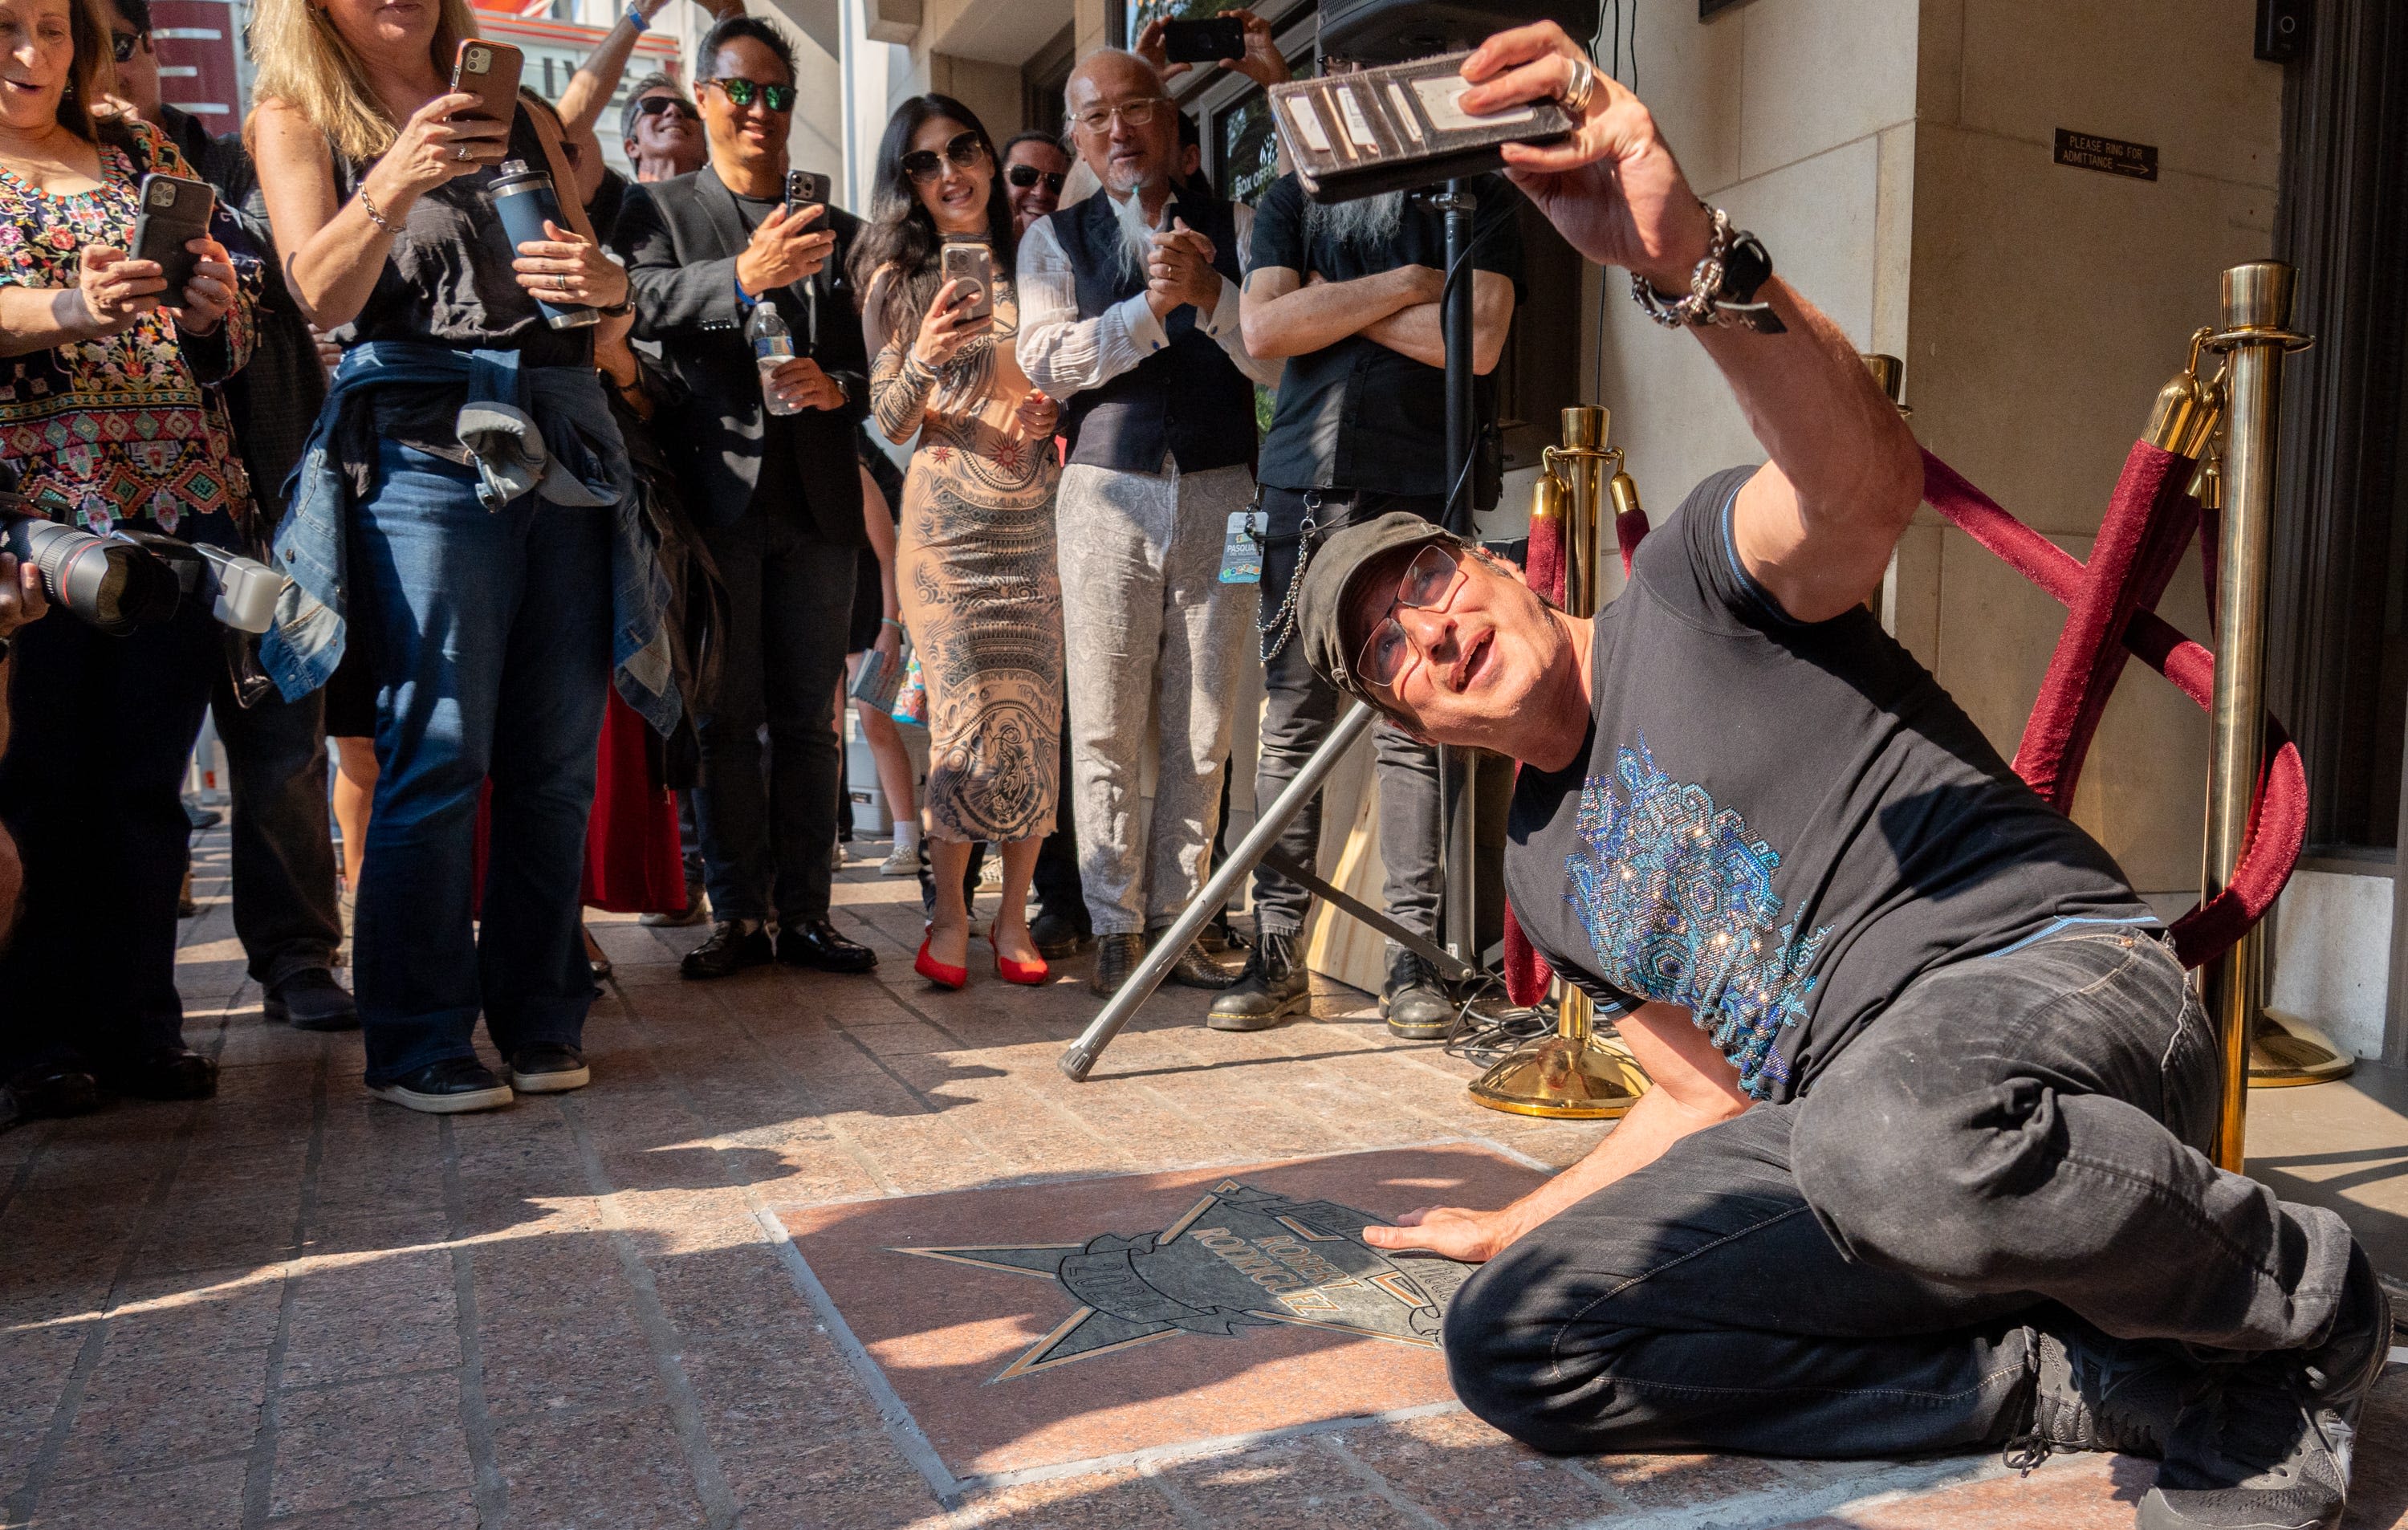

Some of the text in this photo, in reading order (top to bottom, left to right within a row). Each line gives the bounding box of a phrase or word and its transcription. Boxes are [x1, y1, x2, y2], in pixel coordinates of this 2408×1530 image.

[2062, 149, 2113, 169] ADMITTANCE
[2069, 135, 2143, 161] PLEASE RING FOR
[1235, 162, 1279, 197] BOX OFFIC
[1186, 1227, 1342, 1316] RODRIGUEZ
[1251, 1235, 1366, 1291] ROBERT
[1069, 1262, 1165, 1312] 2024
